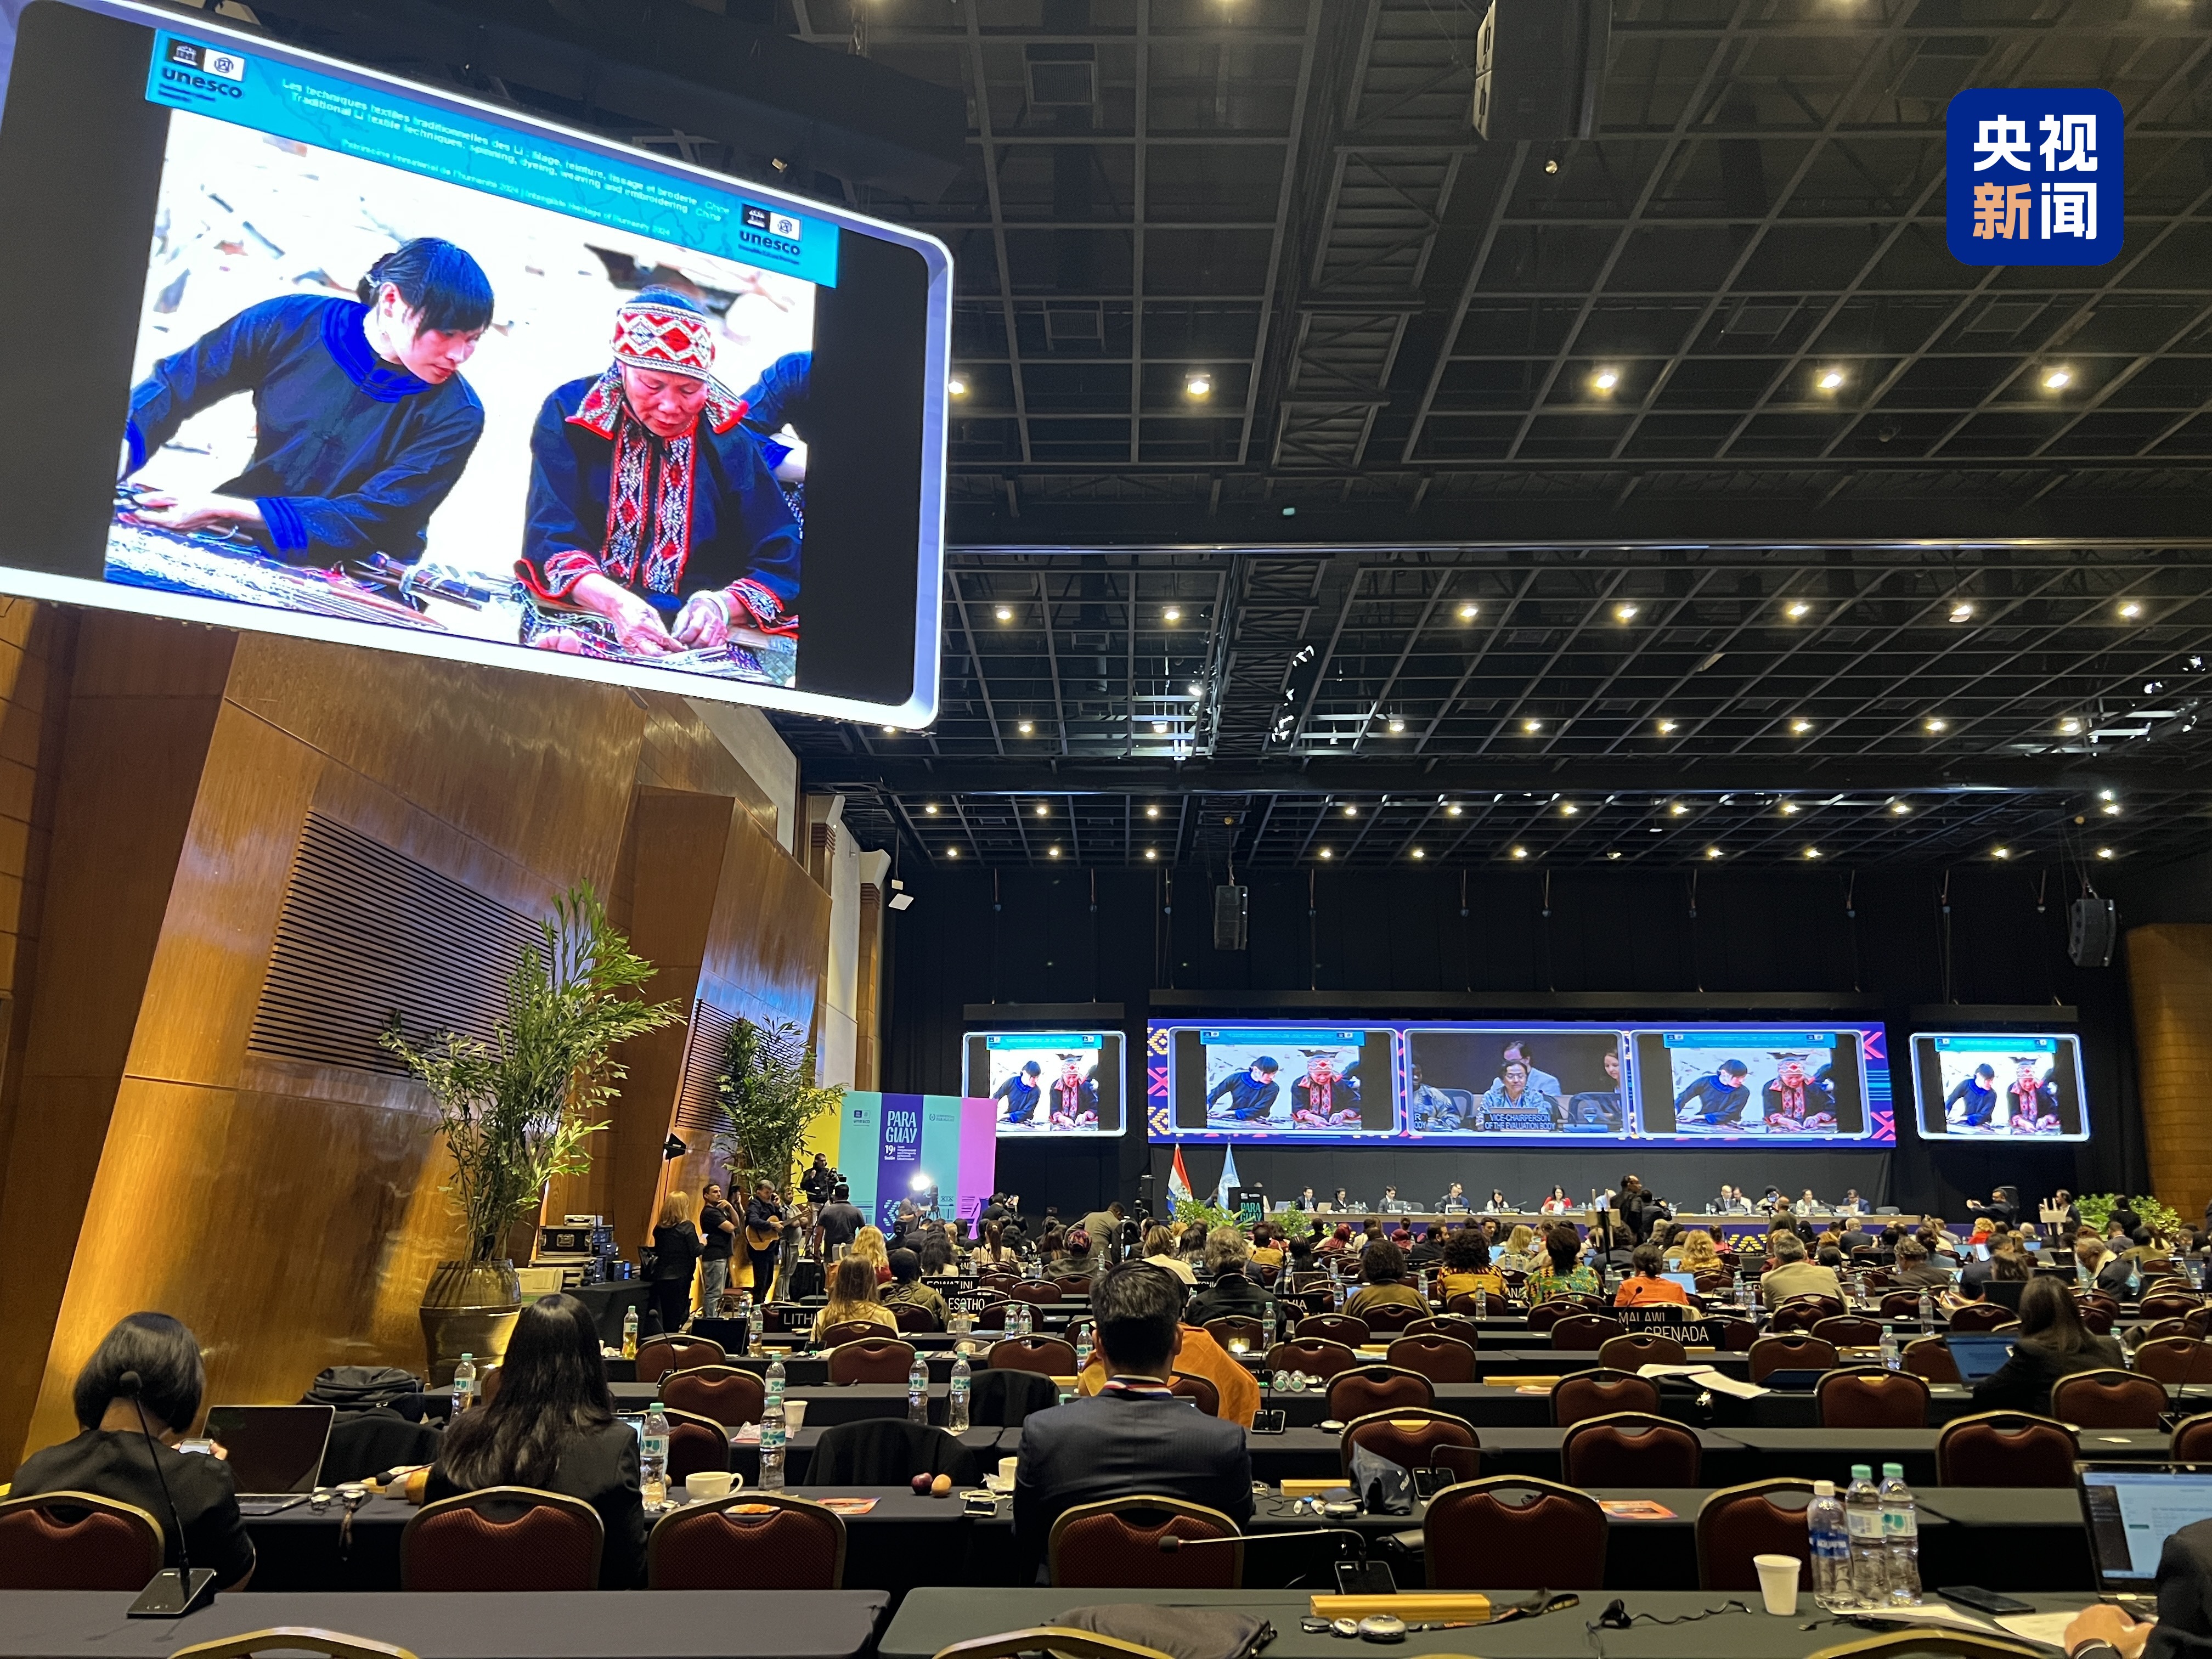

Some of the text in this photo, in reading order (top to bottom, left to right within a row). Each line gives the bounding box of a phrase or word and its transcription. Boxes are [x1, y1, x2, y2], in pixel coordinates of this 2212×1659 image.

[162, 67, 243, 98] unesco
[282, 78, 302, 92] Les
[306, 85, 368, 110] techniques
[371, 104, 410, 123] textiles
[413, 116, 488, 145] traditionnelles
[491, 140, 510, 151] des
[566, 160, 606, 180] teinture,
[608, 173, 644, 190] tissage
[657, 186, 697, 205] broderie
[705, 201, 730, 215] Chine
[291, 92, 352, 116] Traditional
[367, 113, 401, 131] textile
[560, 171, 601, 189] weaving
[604, 183, 623, 194] and
[624, 188, 688, 214] embroidering
[740, 230, 800, 256] unesco
[887, 1110, 917, 1127] PARA
[1414, 1121, 1426, 1129] ODY
[1485, 1121, 1555, 1130] OF THE EVALUATION BODY
[885, 1126, 918, 1143] GUAY
[1240, 1202, 1261, 1213] PARA
[783, 1313, 816, 1325] LITH
